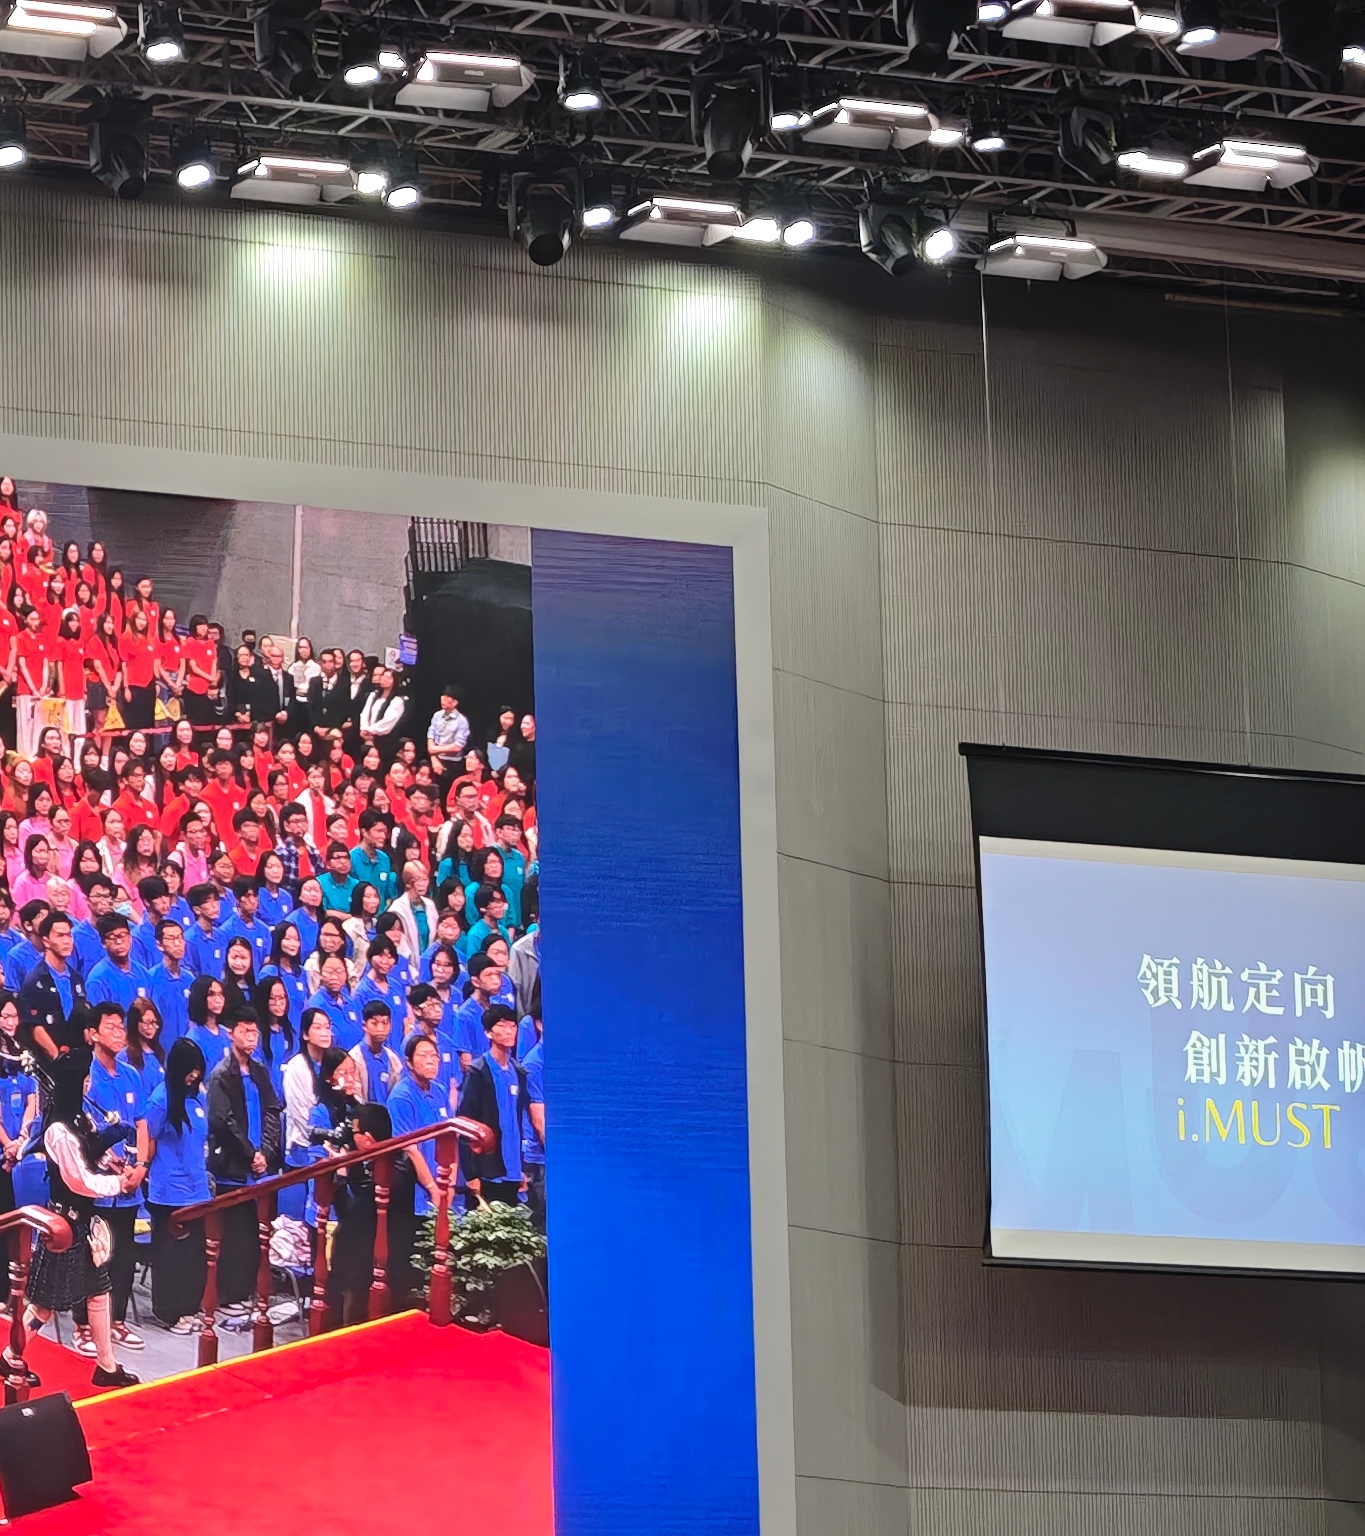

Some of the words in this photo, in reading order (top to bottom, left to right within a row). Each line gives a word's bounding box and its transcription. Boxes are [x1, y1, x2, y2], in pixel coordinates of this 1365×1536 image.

[1136, 953, 1336, 1020] 領航定向
[1176, 1098, 1341, 1150] i.MUST
